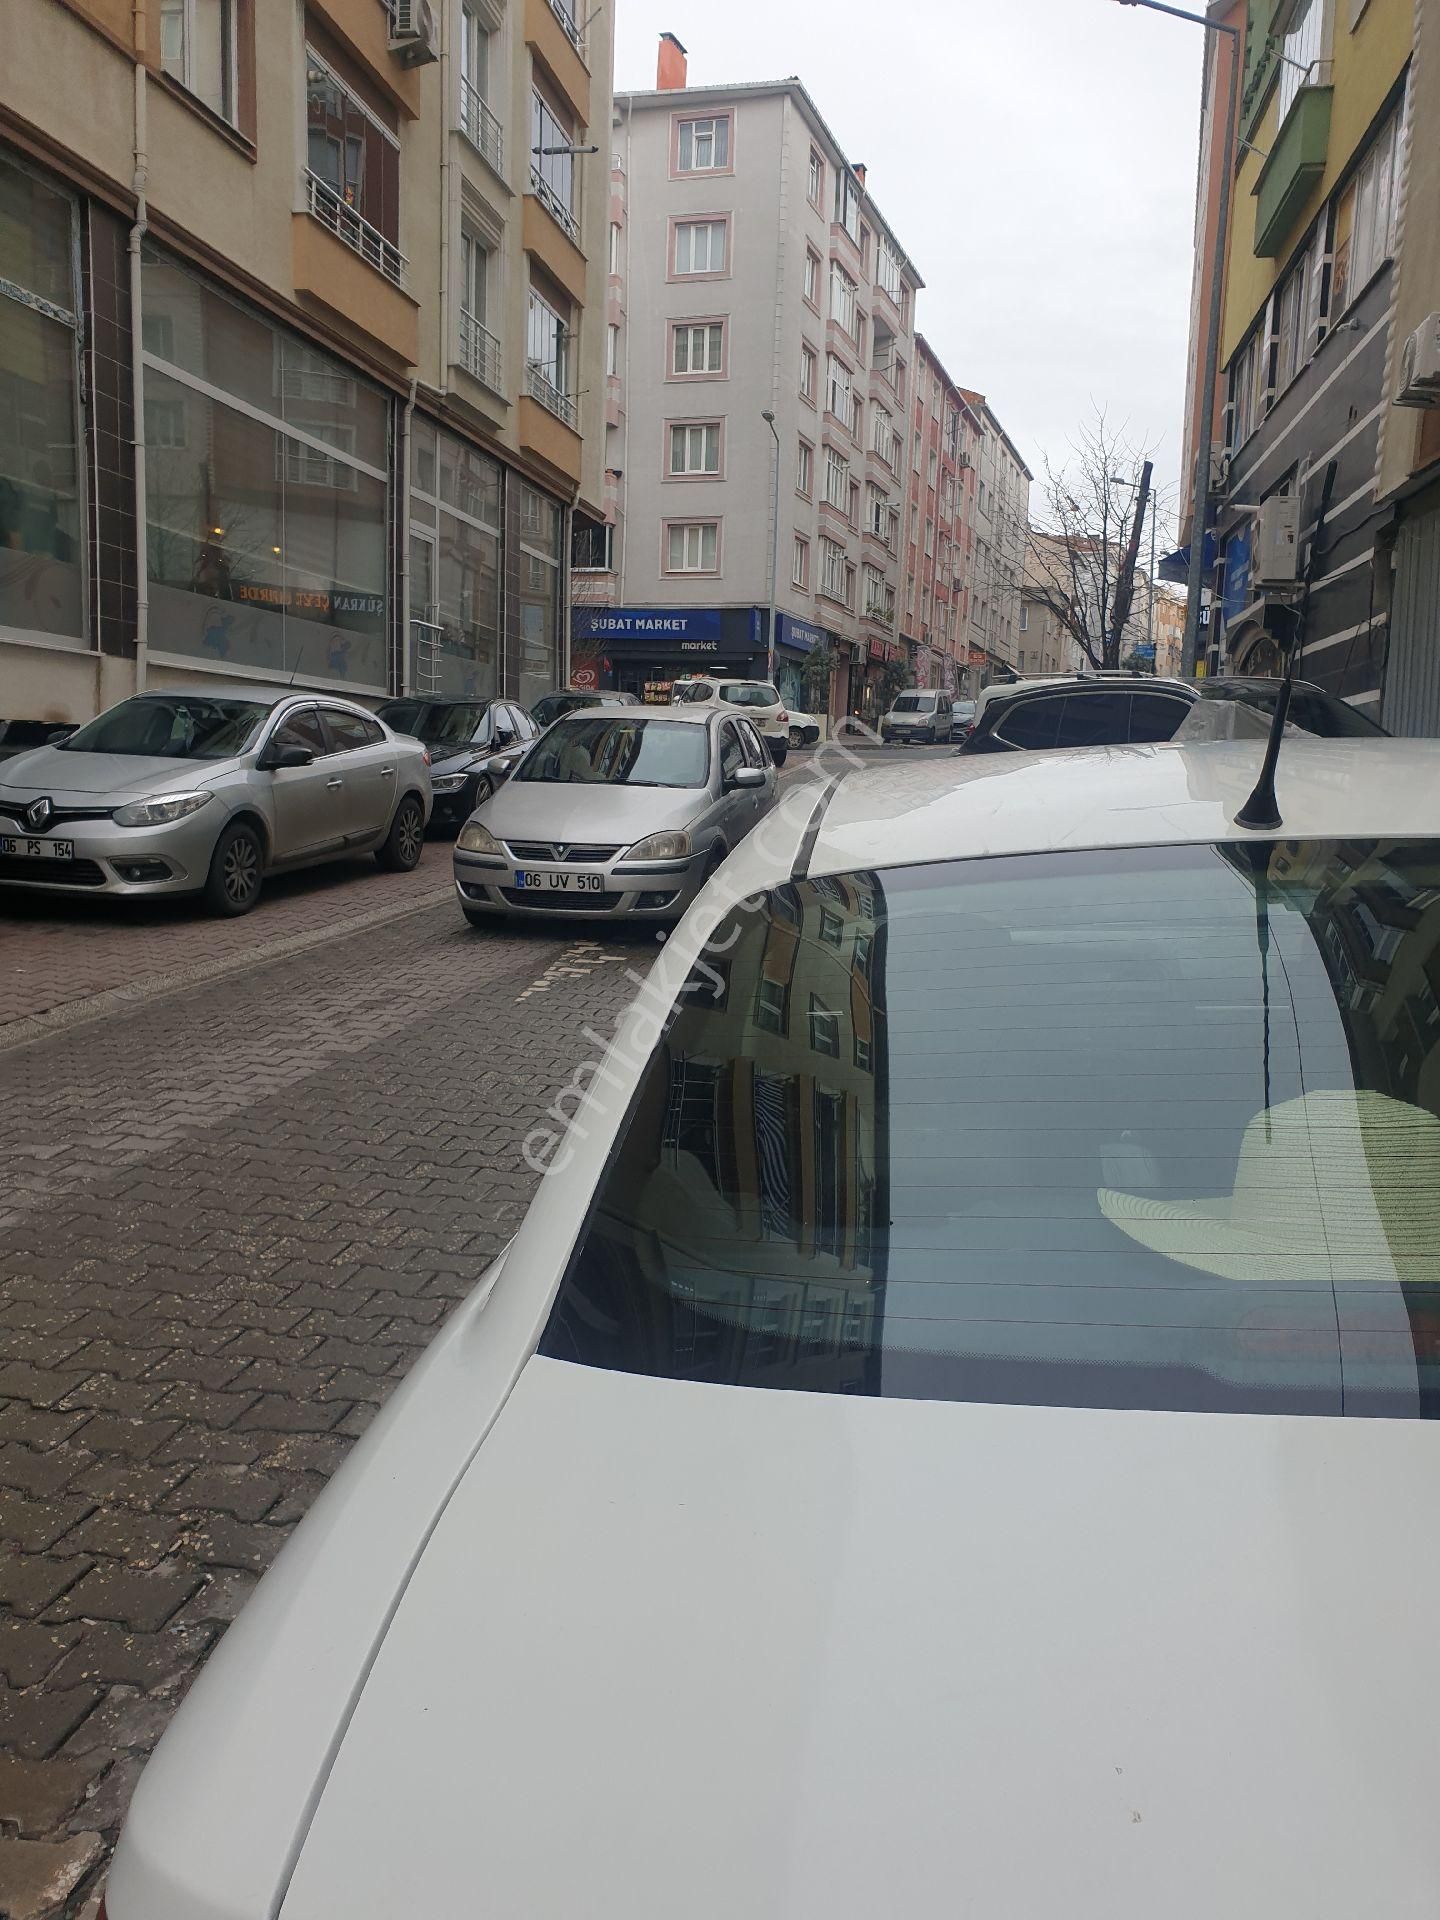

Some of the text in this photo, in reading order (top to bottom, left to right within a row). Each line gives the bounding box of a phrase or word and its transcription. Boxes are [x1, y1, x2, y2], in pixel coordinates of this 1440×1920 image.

[590, 618, 688, 632] ŞUBAT MARKET
[681, 641, 718, 650] market
[27, 840, 41, 855] PS
[53, 842, 71, 857] 154
[525, 873, 541, 887] 06
[549, 874, 570, 889] UV
[577, 875, 600, 890] 510
